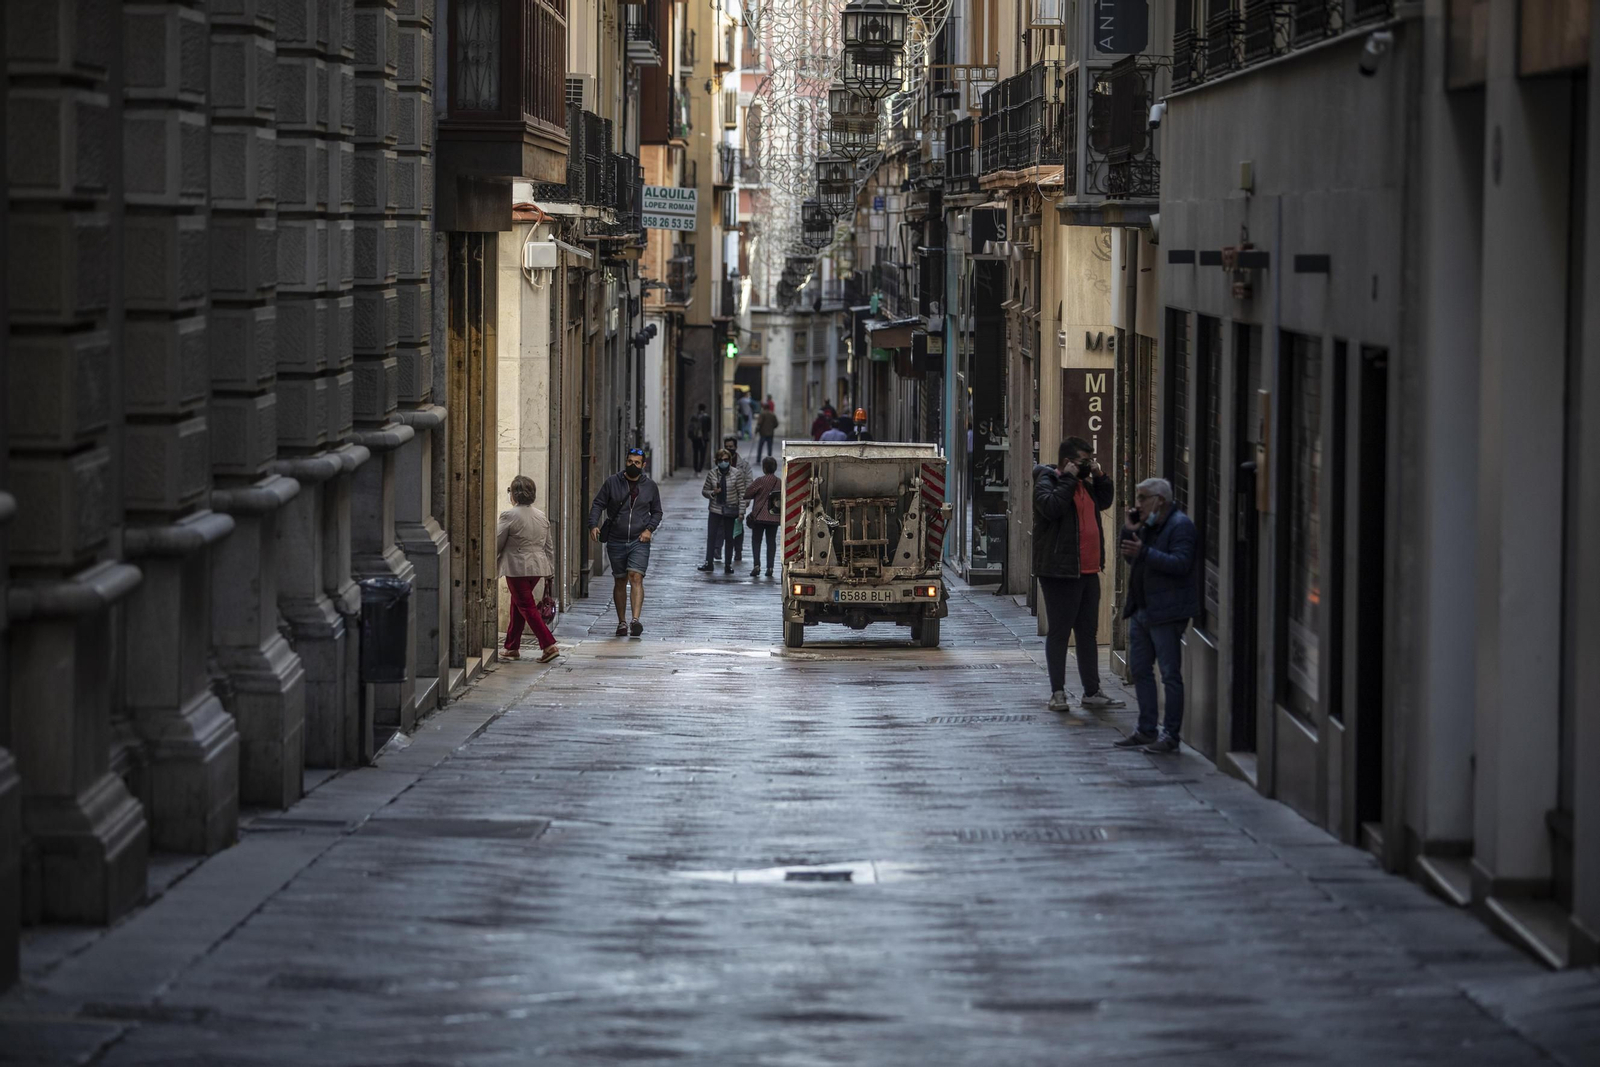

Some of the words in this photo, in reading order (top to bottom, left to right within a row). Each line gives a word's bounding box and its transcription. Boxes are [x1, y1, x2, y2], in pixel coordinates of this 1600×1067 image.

[645, 187, 696, 200] ALQUILA
[644, 201, 667, 209] LOPEZ
[668, 203, 694, 211] ROMAN
[643, 216, 657, 227] 958
[659, 217, 670, 228] 26
[671, 218, 682, 229] 53
[683, 219, 694, 230] 55
[840, 591, 867, 601] 6588
[871, 591, 891, 601] BLH
